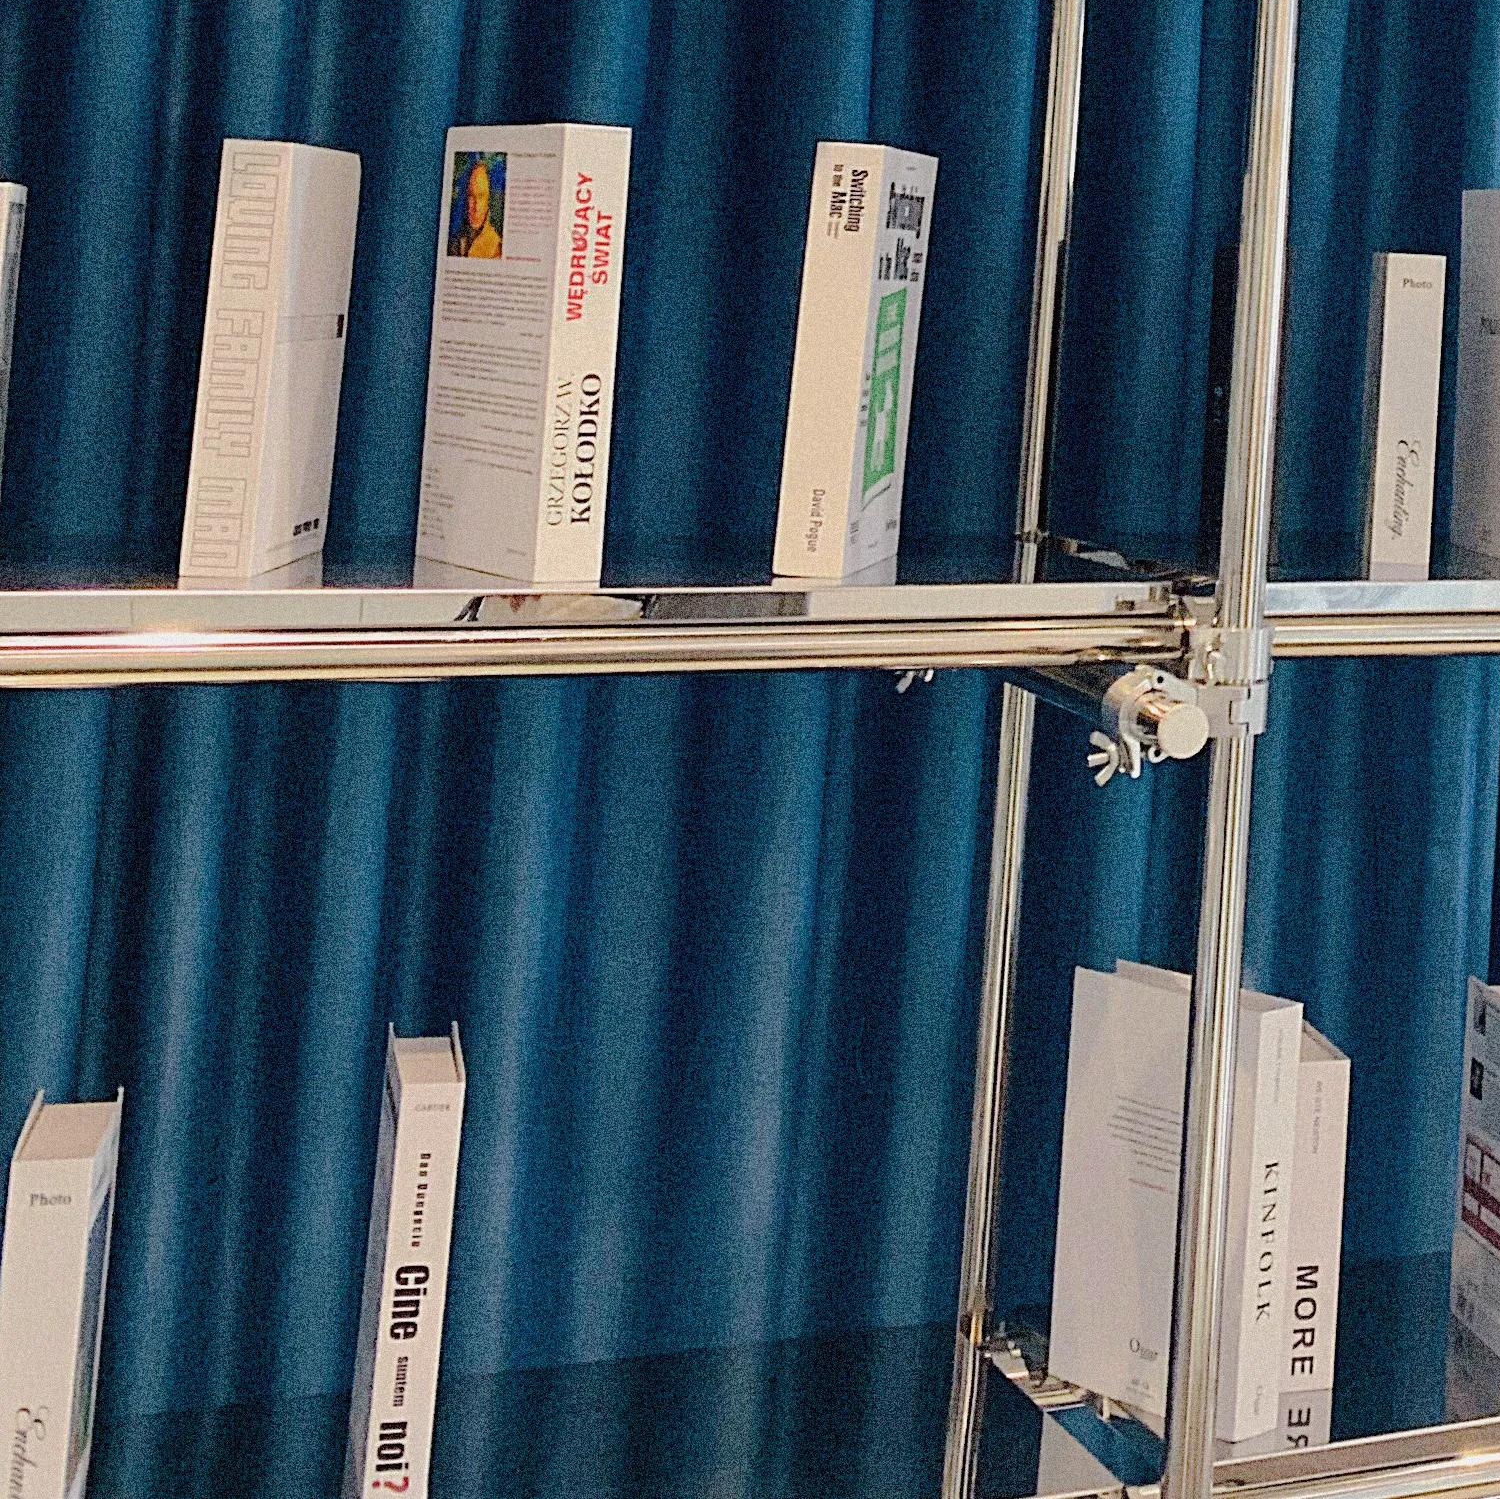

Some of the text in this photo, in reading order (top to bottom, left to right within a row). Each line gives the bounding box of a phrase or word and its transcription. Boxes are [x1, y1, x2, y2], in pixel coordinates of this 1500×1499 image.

[829, 191, 847, 218] Mac
[844, 168, 868, 233] Switching
[592, 210, 614, 285] ŚWIAT
[202, 308, 264, 458] FAMILY
[547, 402, 572, 527] GRZEGORZ
[570, 373, 602, 524] KOŁODKO
[189, 476, 247, 569] MAN
[805, 488, 826, 553] David Pogue
[30, 1191, 73, 1208] Photo
[1255, 1161, 1280, 1324] KINFOLK
[390, 1264, 431, 1340] Cine
[1291, 1264, 1320, 1377] MORE
[392, 1356, 409, 1408] suntem
[371, 1420, 410, 1495] noi?
